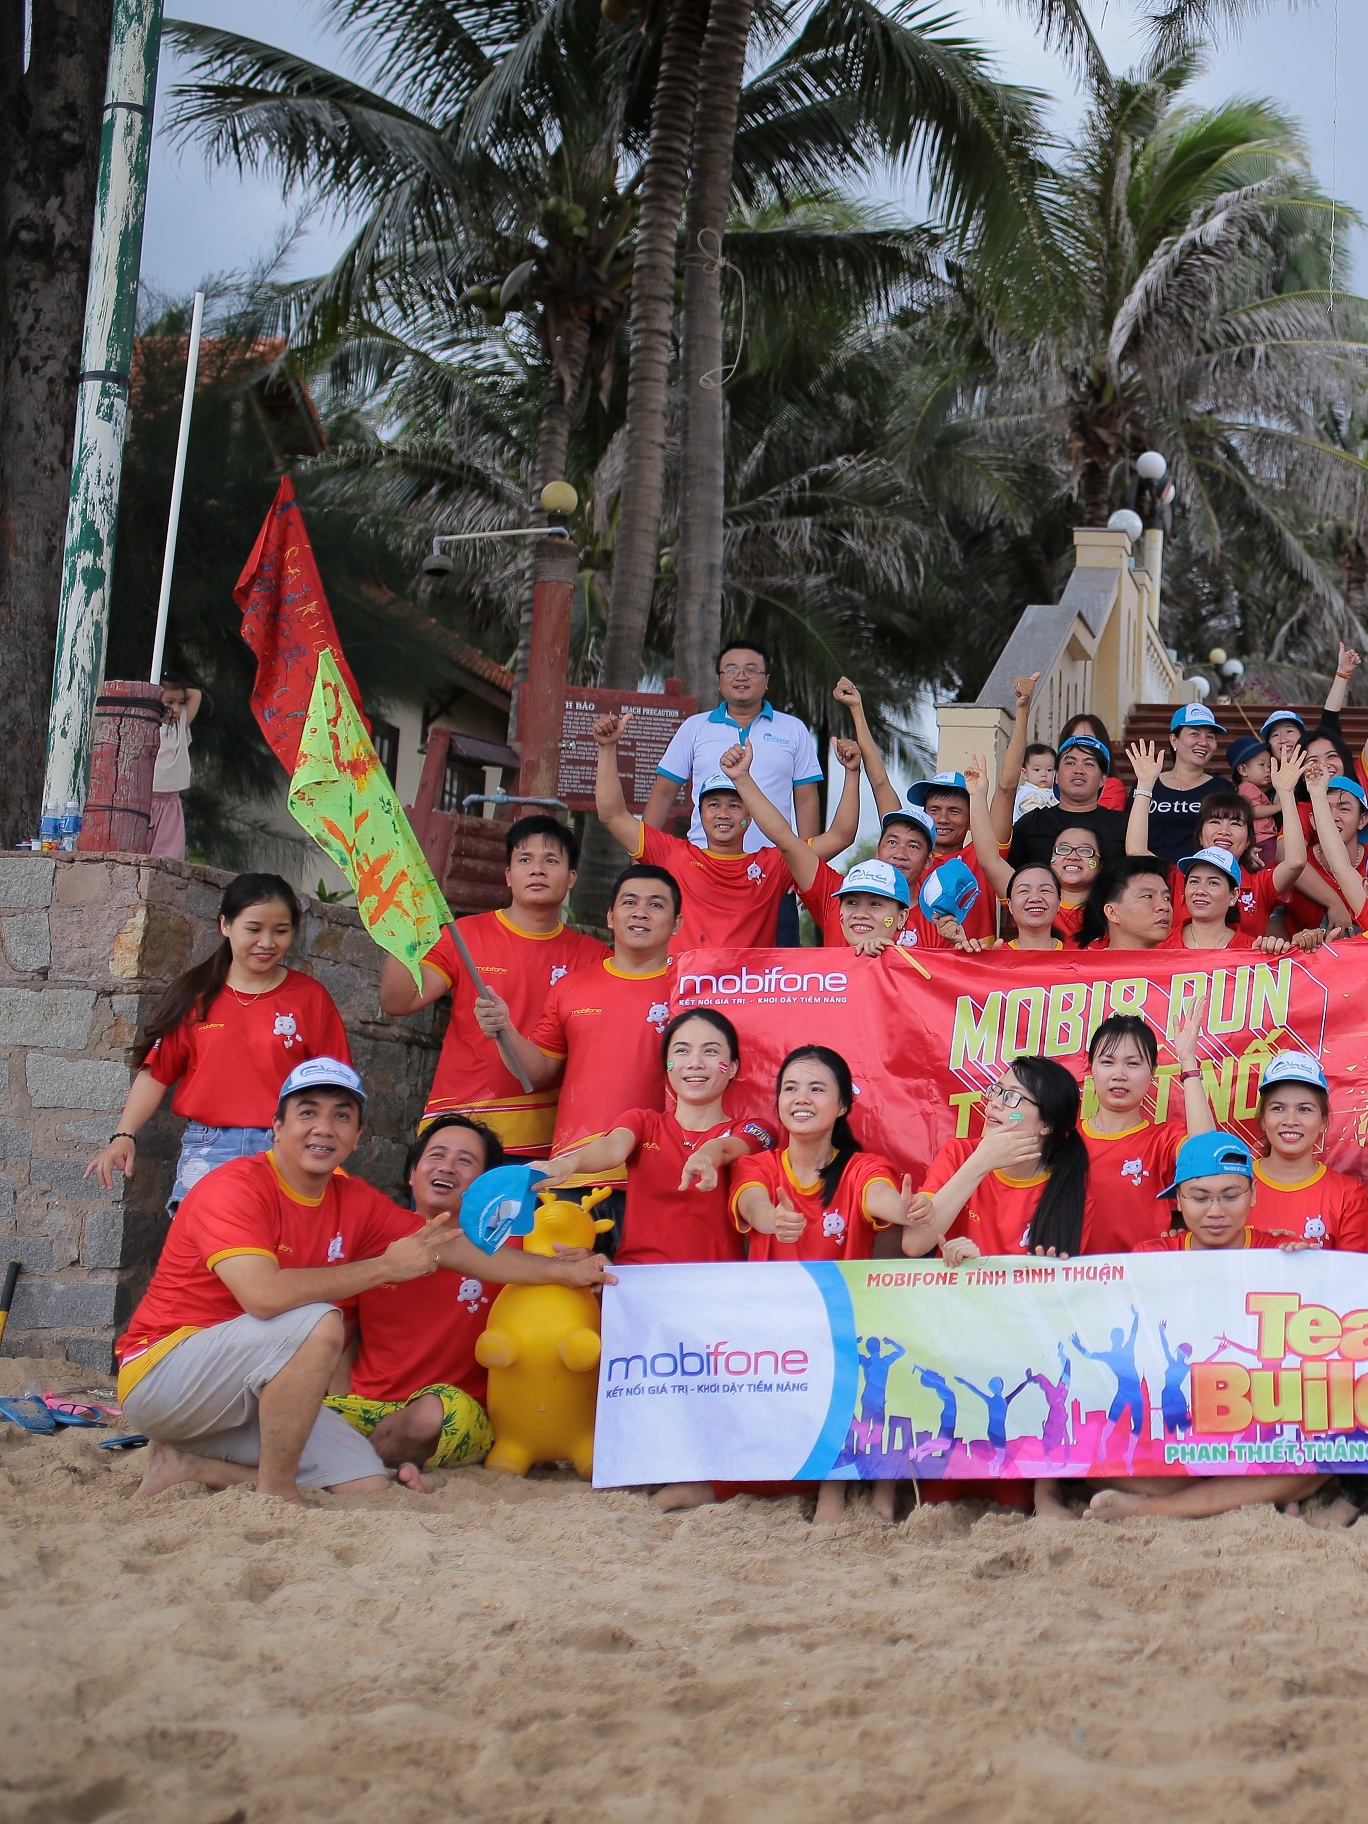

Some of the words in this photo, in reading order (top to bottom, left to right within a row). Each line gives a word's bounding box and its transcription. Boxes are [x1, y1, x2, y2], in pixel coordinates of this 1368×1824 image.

[621, 705, 641, 716] BEACH
[642, 707, 679, 718] PRECAUTION
[679, 966, 848, 994] mobifone
[1166, 958, 1297, 1042] RUN
[1200, 1028, 1292, 1124] NỐ
[867, 1271, 959, 1288] MOBIFONE
[965, 1267, 1007, 1286] TỈNH
[1013, 1264, 1056, 1285] BÌNH
[1062, 1262, 1125, 1285] THUẬN
[606, 1340, 809, 1382] mobifone
[606, 1387, 624, 1399] KẾT
[626, 1382, 645, 1396] NỐI
[647, 1382, 668, 1395] GIÁ
[670, 1384, 689, 1396] TRỊ
[722, 1381, 745, 1395] DẬY
[1164, 1443, 1230, 1464] PHAN
